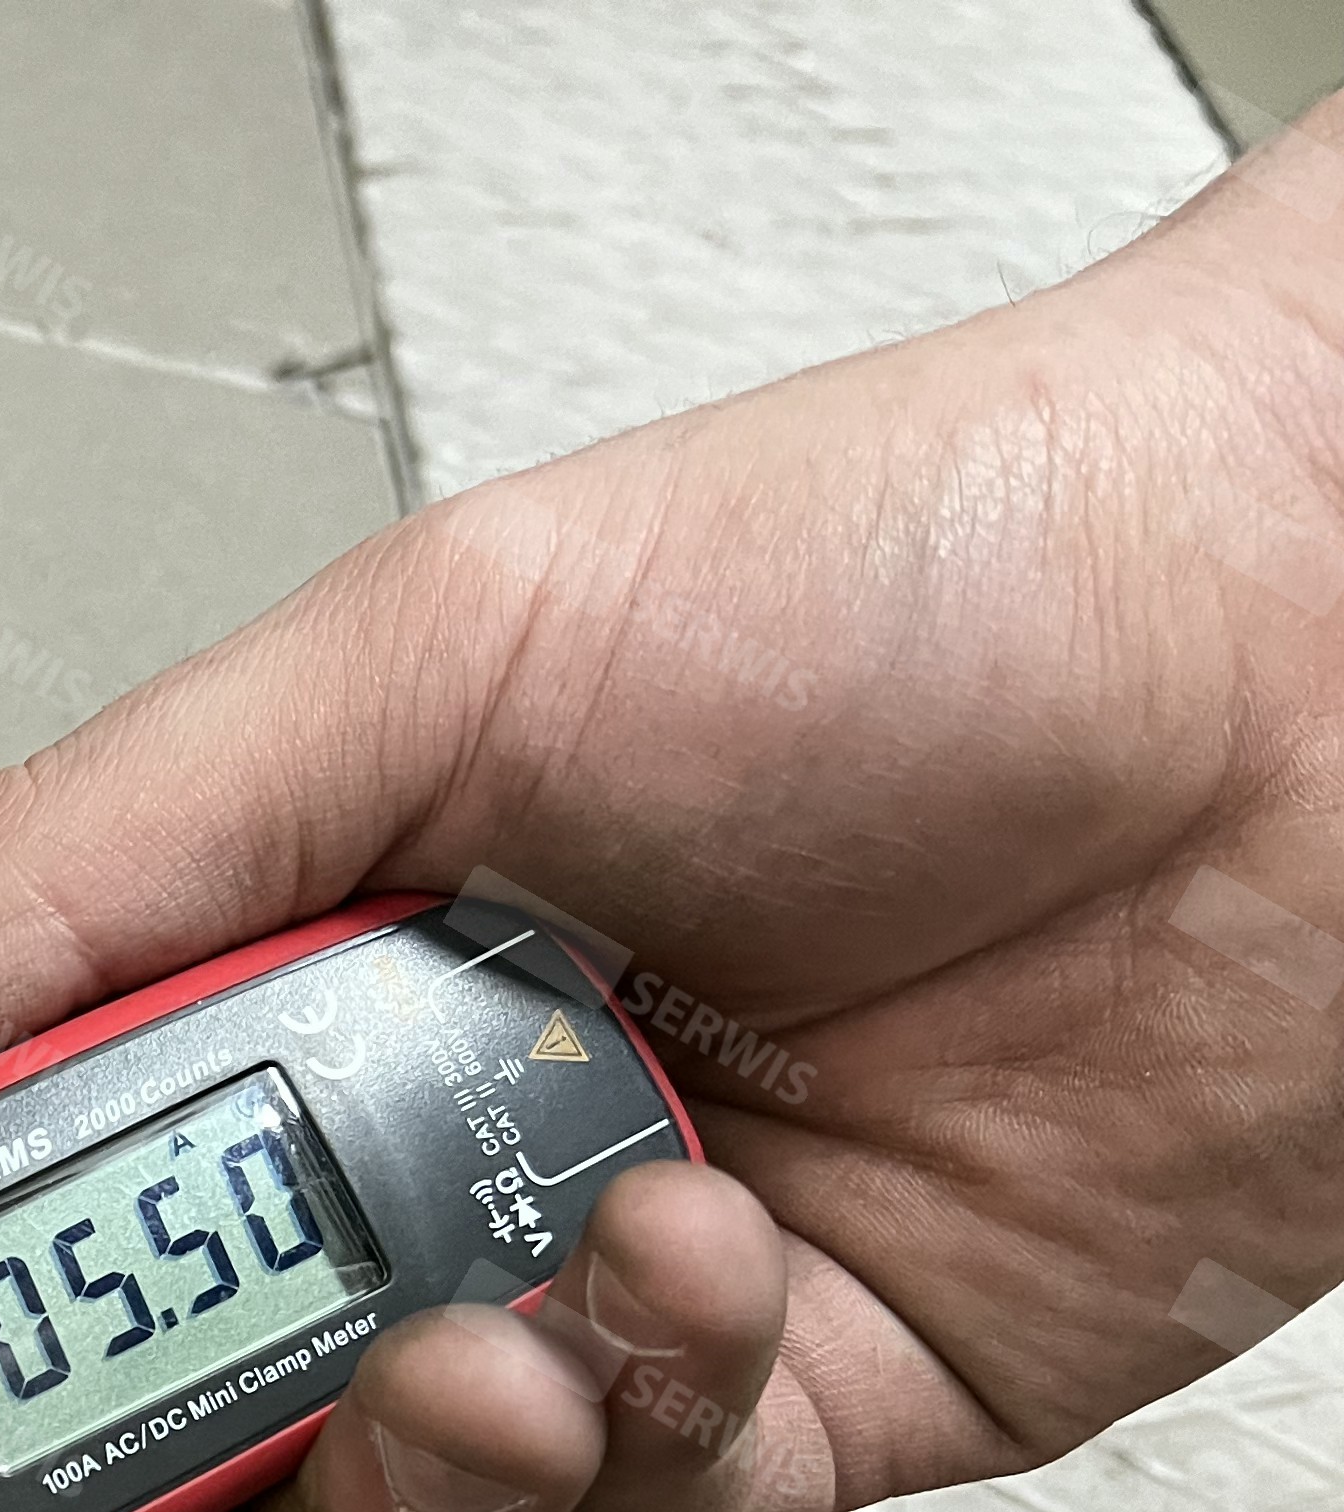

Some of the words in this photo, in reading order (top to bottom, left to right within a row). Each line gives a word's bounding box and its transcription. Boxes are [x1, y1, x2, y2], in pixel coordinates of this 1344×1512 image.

[422, 1038, 464, 1088] 300V
[443, 1028, 483, 1077] 600V
[74, 1093, 136, 1139] 2000
[140, 1047, 233, 1104] Counts
[453, 1088, 478, 1112] III
[475, 1082, 497, 1099] II
[172, 1132, 196, 1157] A
[466, 1116, 500, 1157] CAT
[486, 1104, 522, 1146] CAT
[523, 1231, 553, 1258] V
[42, 1454, 102, 1494] 100A
[105, 1407, 187, 1465] AC/DC
[187, 1381, 238, 1421] Mini
[238, 1348, 312, 1395] Clamp
[311, 1312, 378, 1357] Meter
